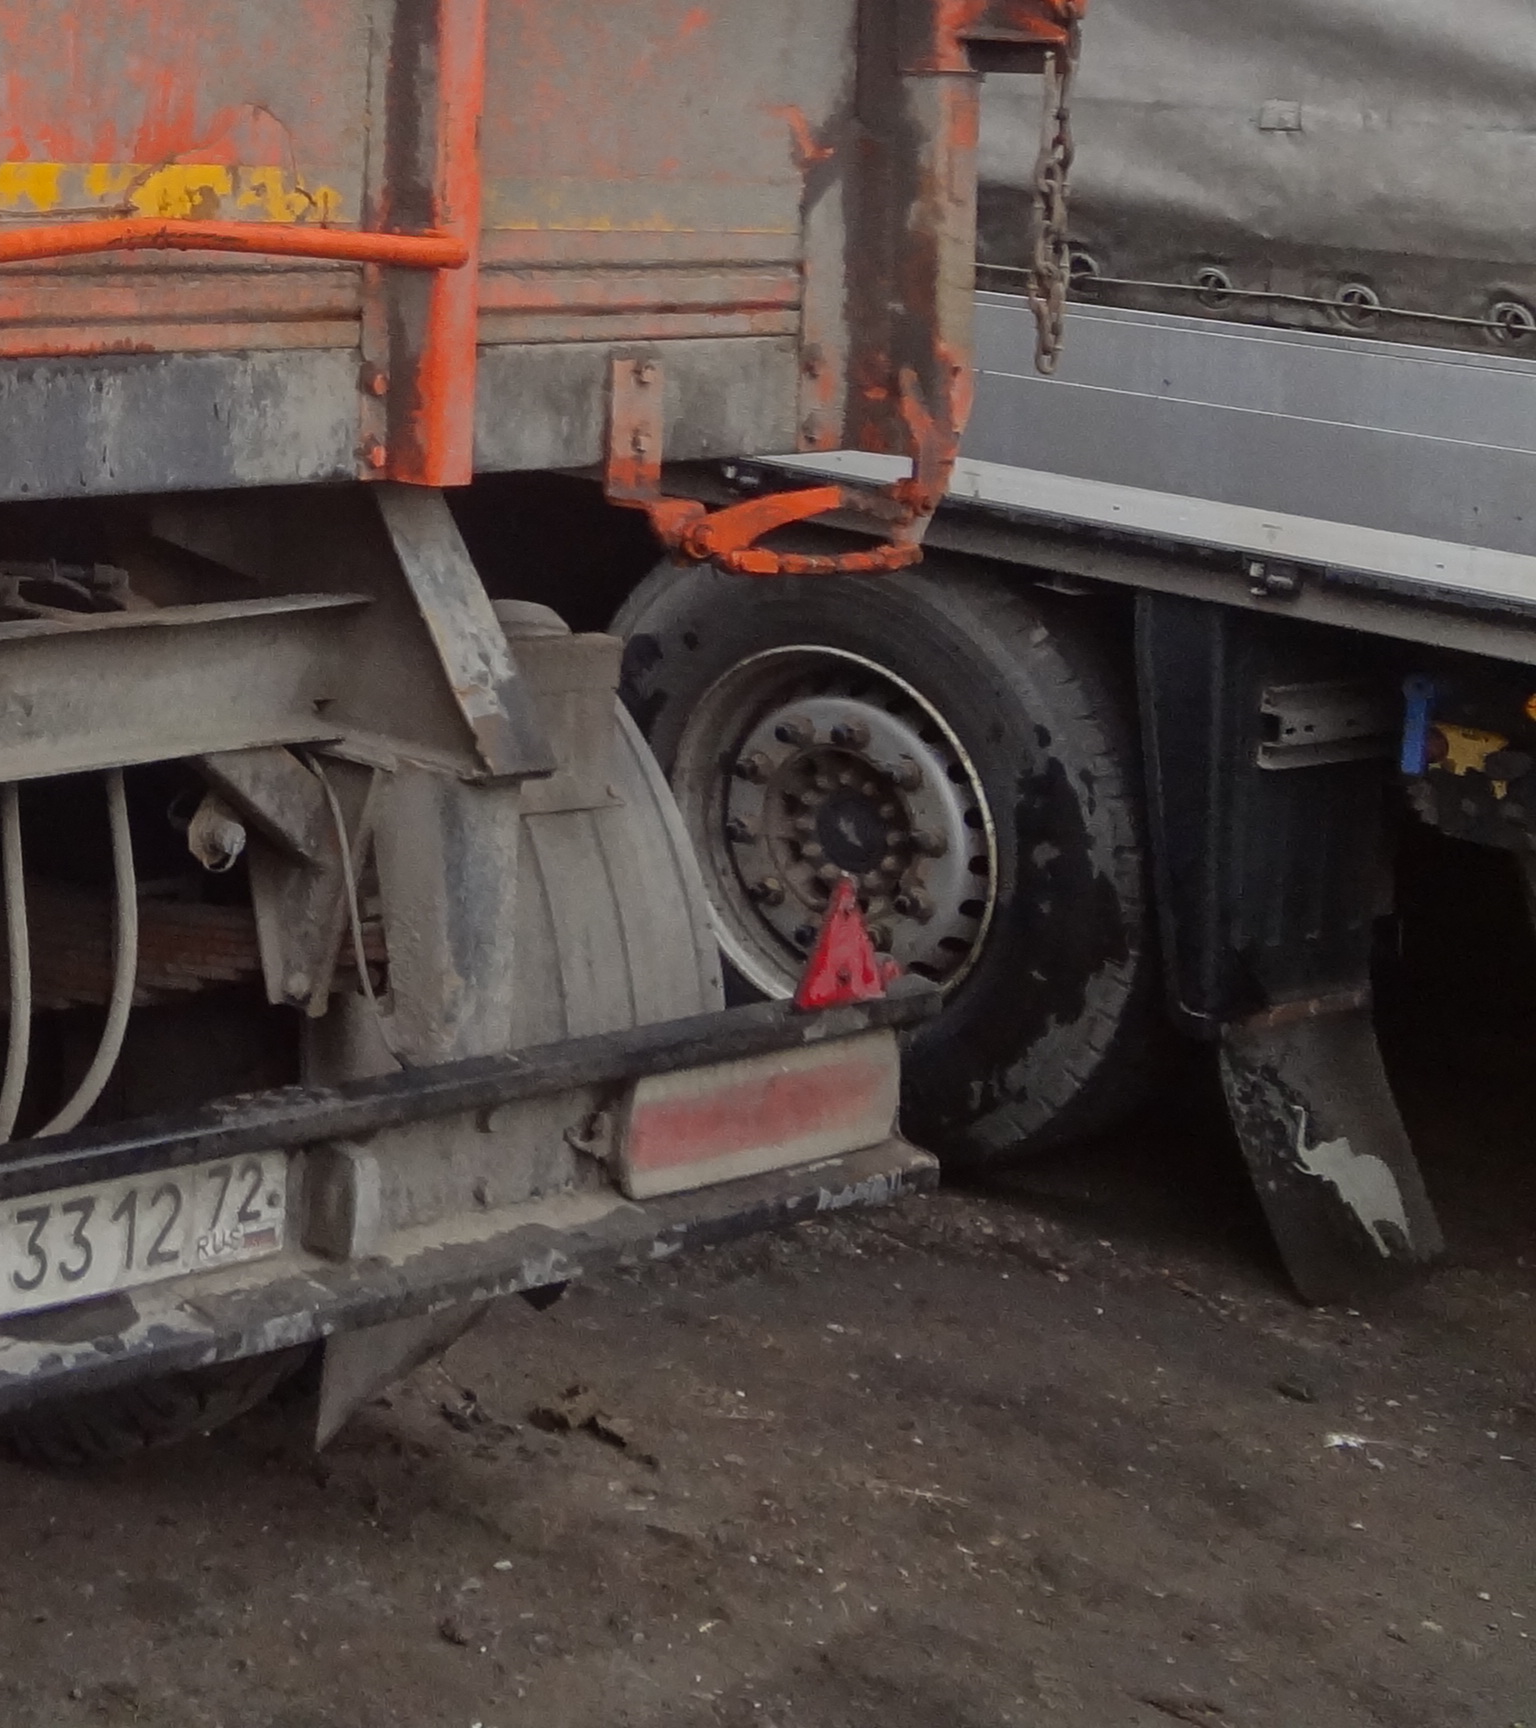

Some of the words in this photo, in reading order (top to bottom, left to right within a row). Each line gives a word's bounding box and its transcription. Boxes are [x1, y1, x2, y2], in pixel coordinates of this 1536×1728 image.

[12, 1183, 183, 1290] 3312
[208, 1160, 263, 1231] 72
[197, 1229, 240, 1257] RUS
